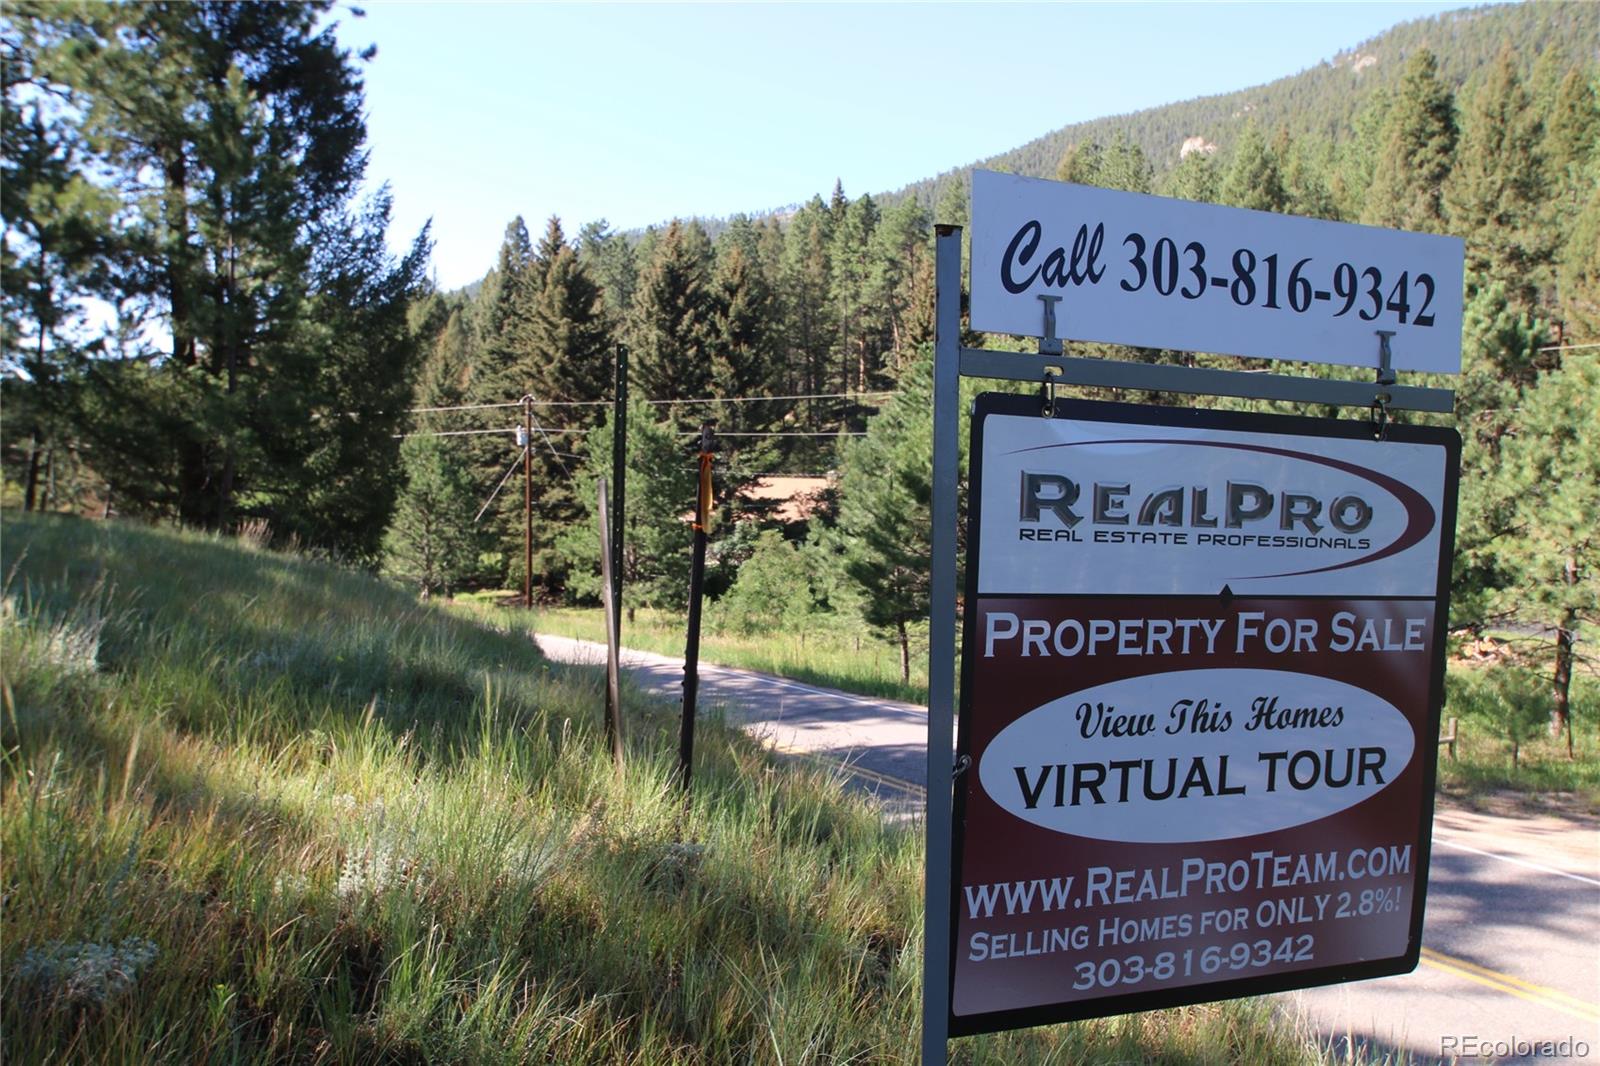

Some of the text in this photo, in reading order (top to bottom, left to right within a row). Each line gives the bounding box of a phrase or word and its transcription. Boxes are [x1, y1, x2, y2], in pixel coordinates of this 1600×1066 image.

[1000, 220, 1436, 328] Call 303-816-9342
[1019, 528, 1371, 550] REAL ESTATE PROFESSIONALS
[983, 608, 1427, 659] PROPERTY FOR SALE
[1075, 695, 1345, 739] View This Homes
[1013, 746, 1387, 810] VIRTUAL TOUR
[968, 886, 1402, 962] SELLING HOMES FOR ONLY 2.8%!
[1071, 933, 1315, 992] 303-816-9342
